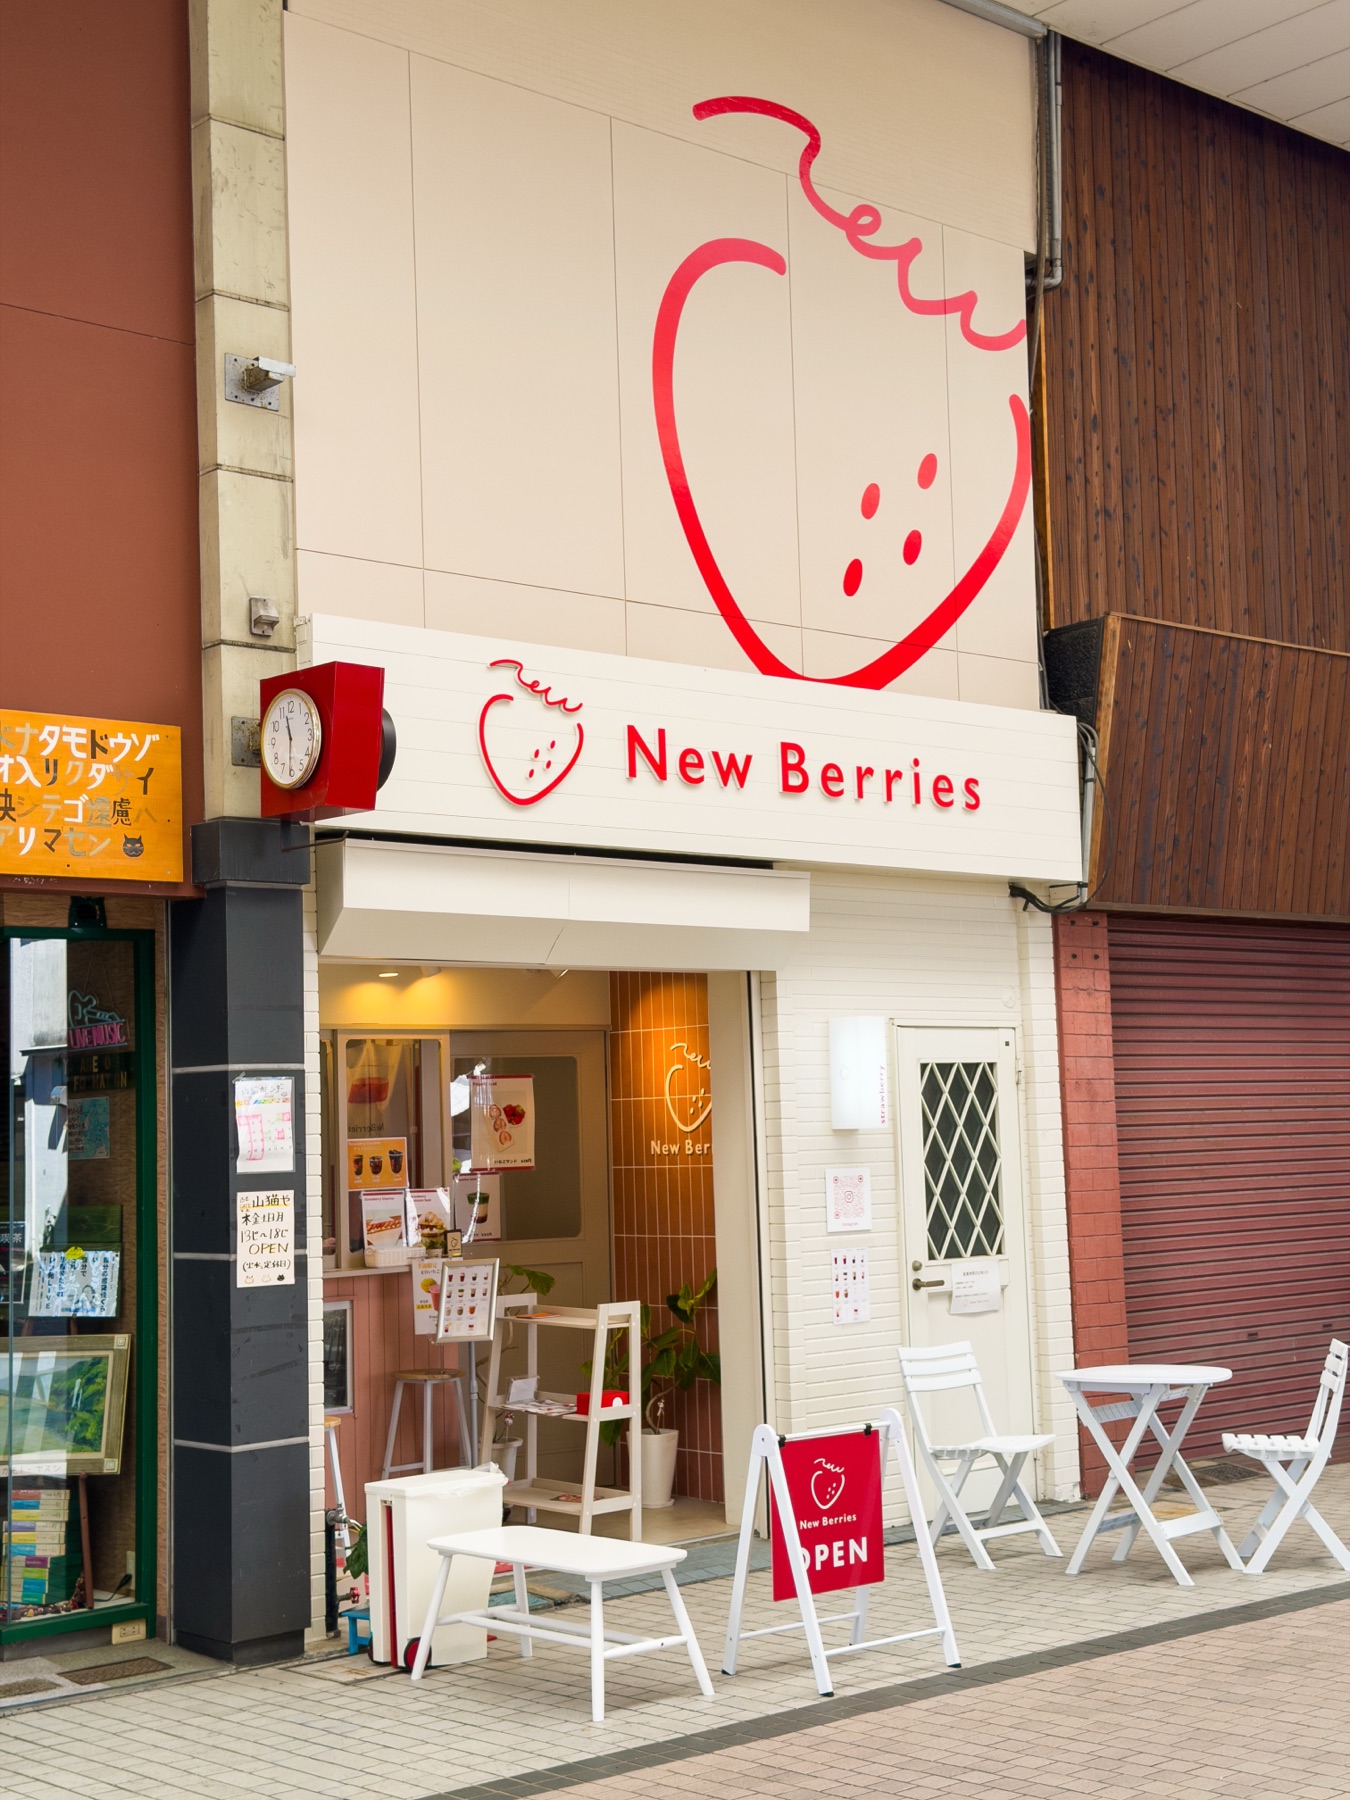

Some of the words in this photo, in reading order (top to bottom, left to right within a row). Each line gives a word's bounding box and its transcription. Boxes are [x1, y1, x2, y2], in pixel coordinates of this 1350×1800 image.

[287, 700, 295, 713] 12
[279, 707, 285, 720] 11
[304, 712, 310, 725] 2
[271, 720, 280, 732] 10
[307, 728, 313, 741] 3
[270, 737, 276, 749] 9
[305, 746, 310, 757] 4
[273, 752, 279, 765] 8
[299, 759, 304, 771] 5
[281, 763, 285, 774] 7
[625, 723, 753, 789] New
[778, 741, 981, 811] Berries
[69, 1027, 93, 1049] LIVE
[92, 1022, 126, 1046] MUSIC
[650, 1140, 680, 1155] New
[685, 1139, 713, 1155] Ber
[252, 1193, 291, 1208] 山猫や
[248, 1243, 289, 1255] OPEN
[800, 1519, 820, 1530] New
[822, 1513, 857, 1527] Berries
